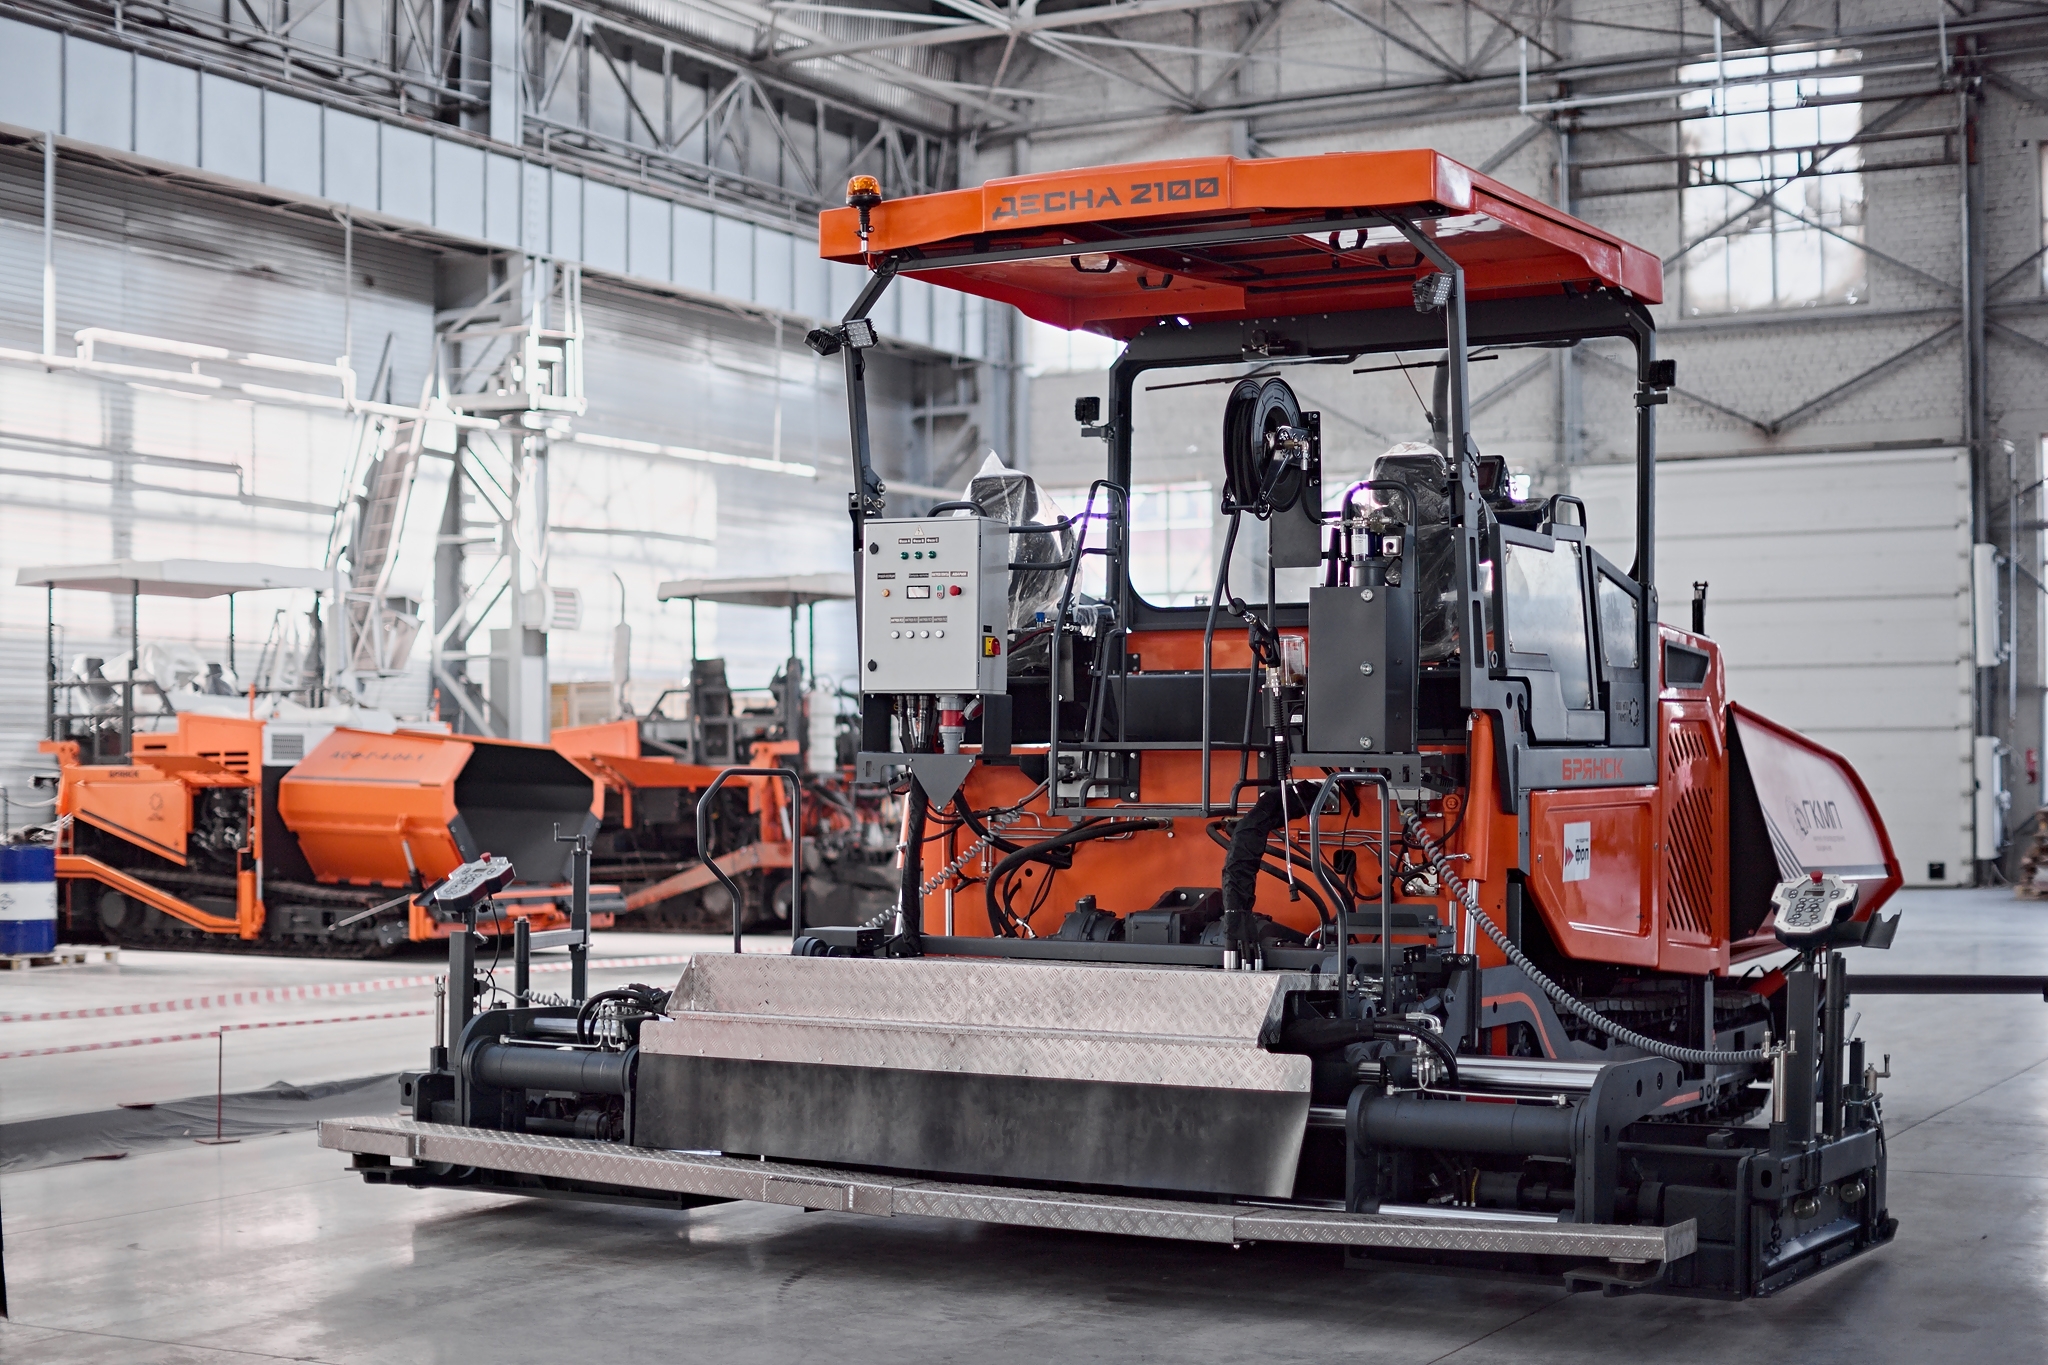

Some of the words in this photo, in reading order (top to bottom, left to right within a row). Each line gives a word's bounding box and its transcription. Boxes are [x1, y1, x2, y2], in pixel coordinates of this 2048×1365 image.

[992, 186, 1122, 221] ДЕСНА
[1130, 177, 1220, 205] 2100
[1561, 757, 1625, 781] БРЯНСК
[1802, 800, 1843, 829] ГКМП
